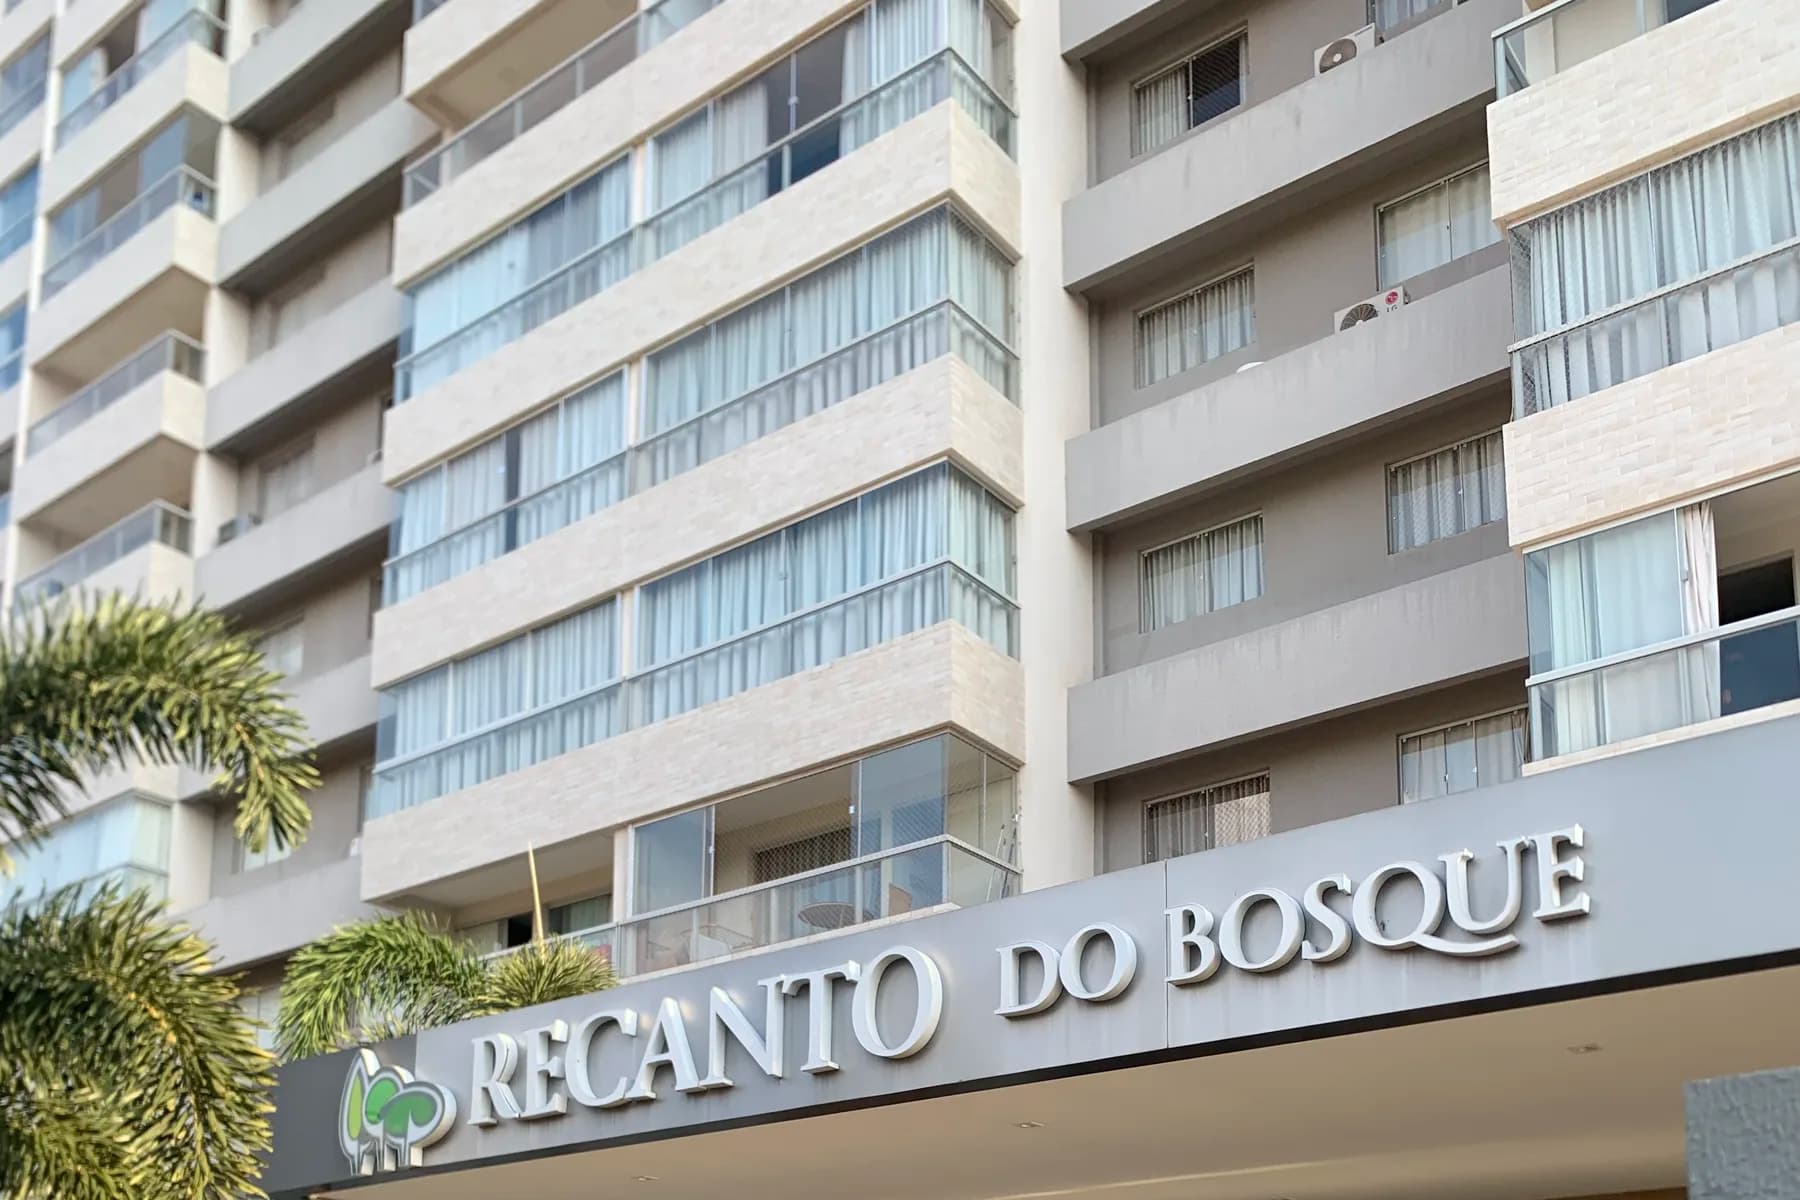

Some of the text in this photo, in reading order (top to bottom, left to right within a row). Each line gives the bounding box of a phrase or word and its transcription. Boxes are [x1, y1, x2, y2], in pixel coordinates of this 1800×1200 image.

[467, 823, 1591, 1128] RECANTO DO BOSQUE
